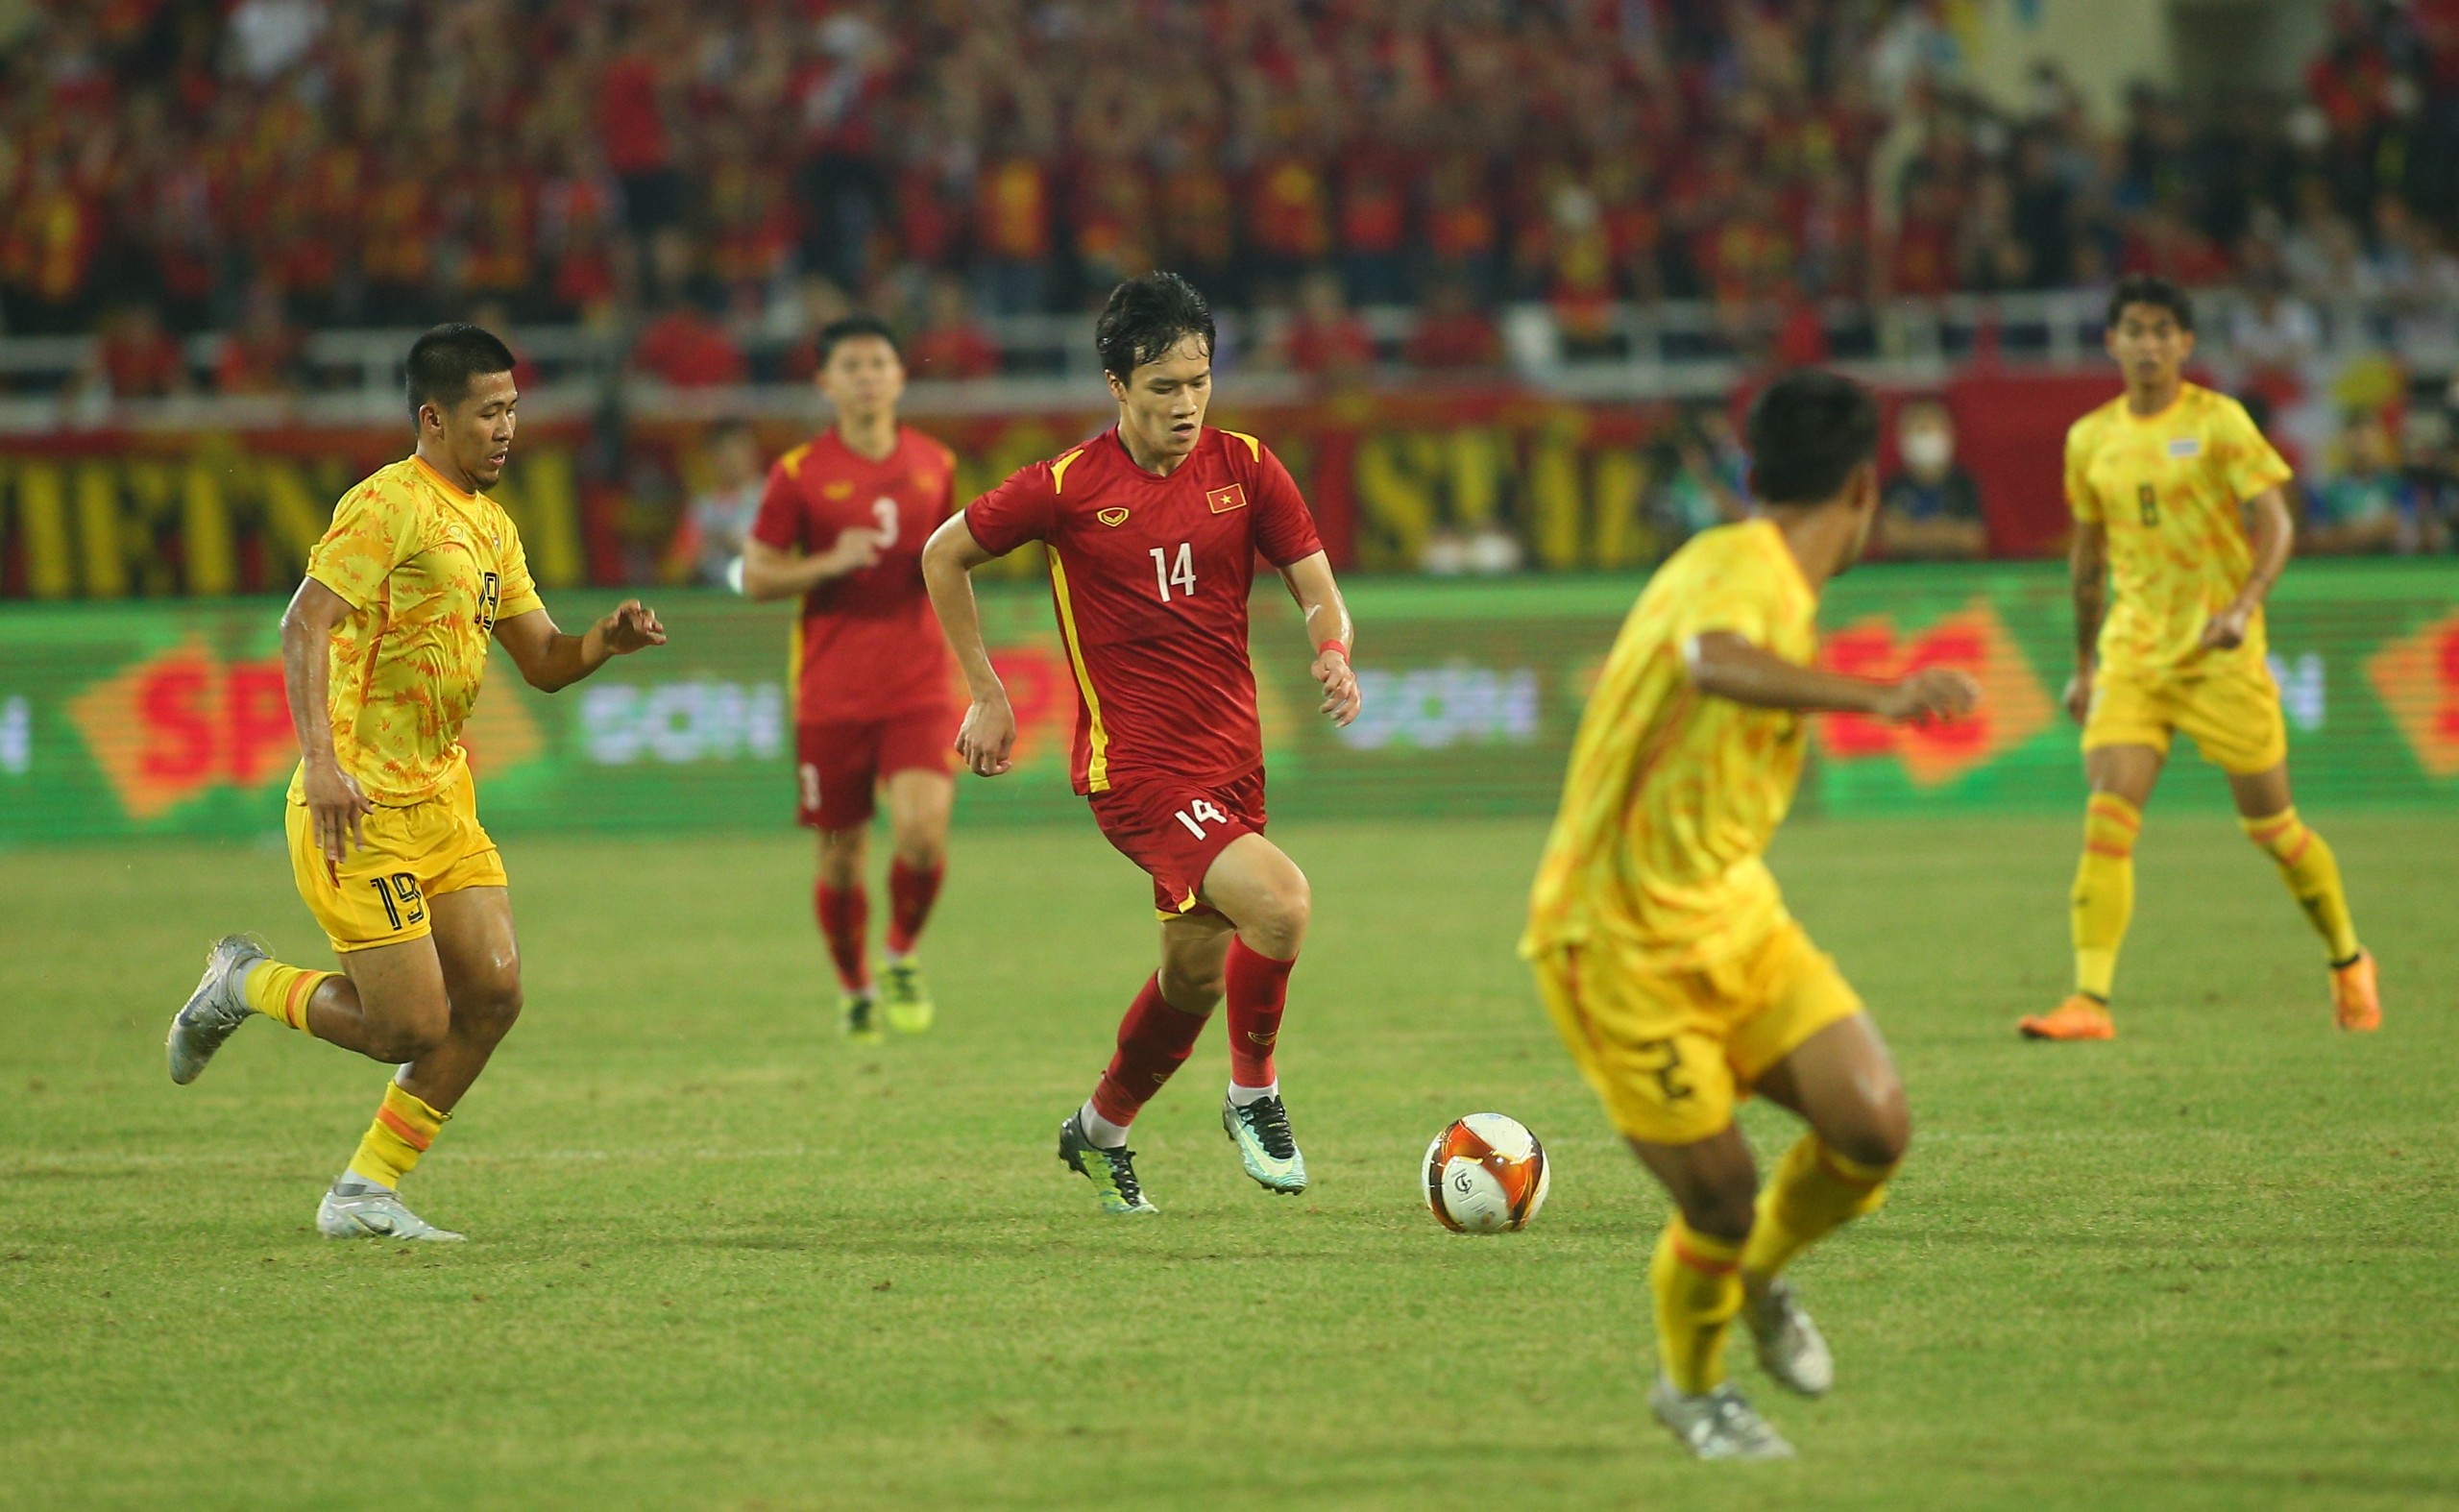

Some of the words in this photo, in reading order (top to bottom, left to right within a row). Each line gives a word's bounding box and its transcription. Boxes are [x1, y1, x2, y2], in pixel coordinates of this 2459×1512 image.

[871, 496, 898, 550] 3
[2137, 483, 2160, 527] 8
[1149, 542, 1197, 602] 14
[137, 659, 300, 783] SP
[1174, 798, 1228, 841] 14
[369, 872, 425, 931] 19
[1635, 1038, 1693, 1102] 2
